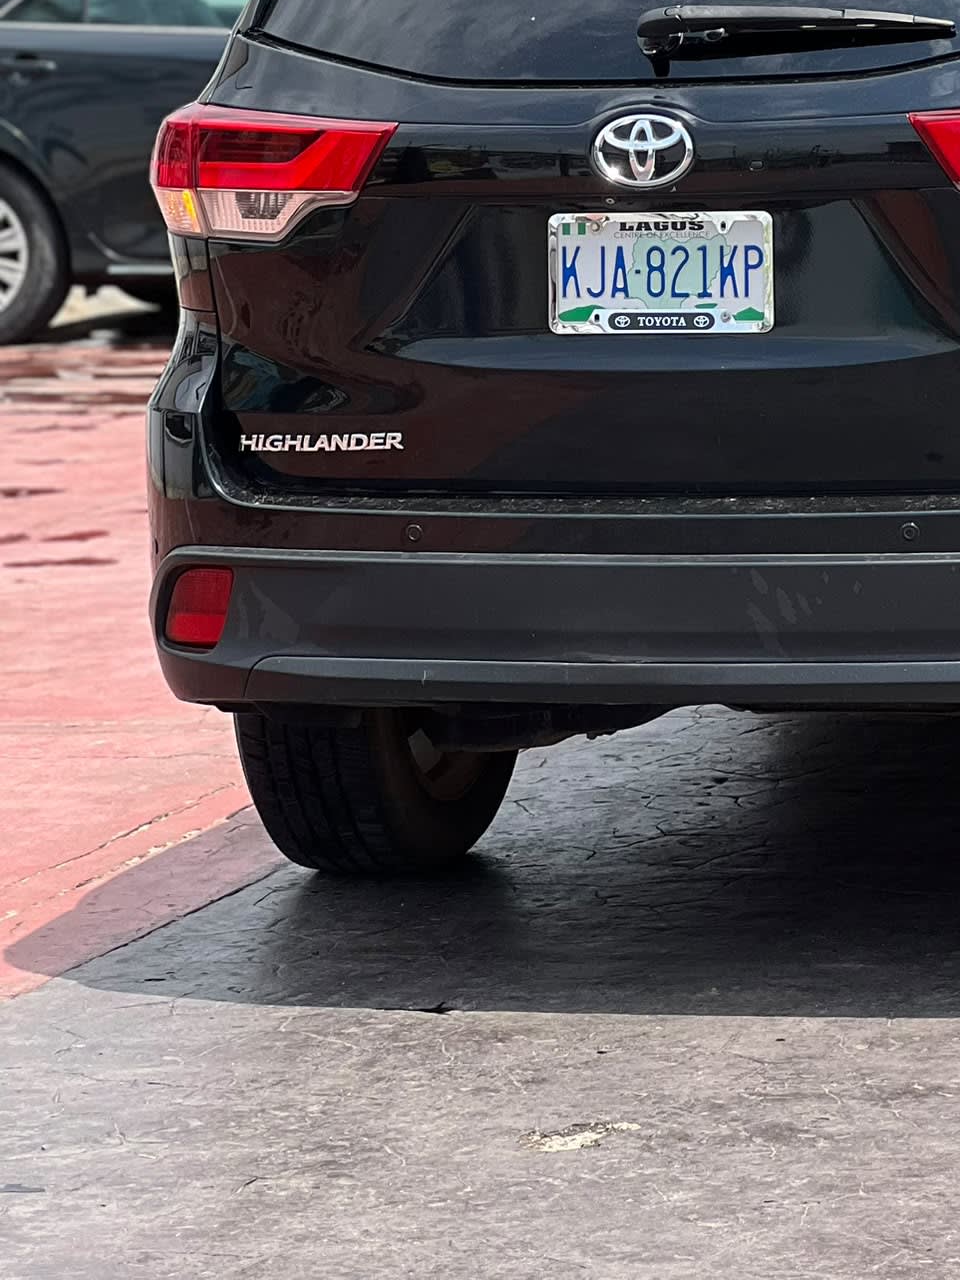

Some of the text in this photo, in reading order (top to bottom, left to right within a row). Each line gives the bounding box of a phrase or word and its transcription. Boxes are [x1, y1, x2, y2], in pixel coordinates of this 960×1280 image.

[619, 221, 704, 231] LAGOS
[660, 231, 711, 239] EXCELLENCE
[562, 245, 764, 298] KJA-821KP
[638, 316, 687, 327] TOYOTA
[240, 432, 404, 452] HIGHLANDER
